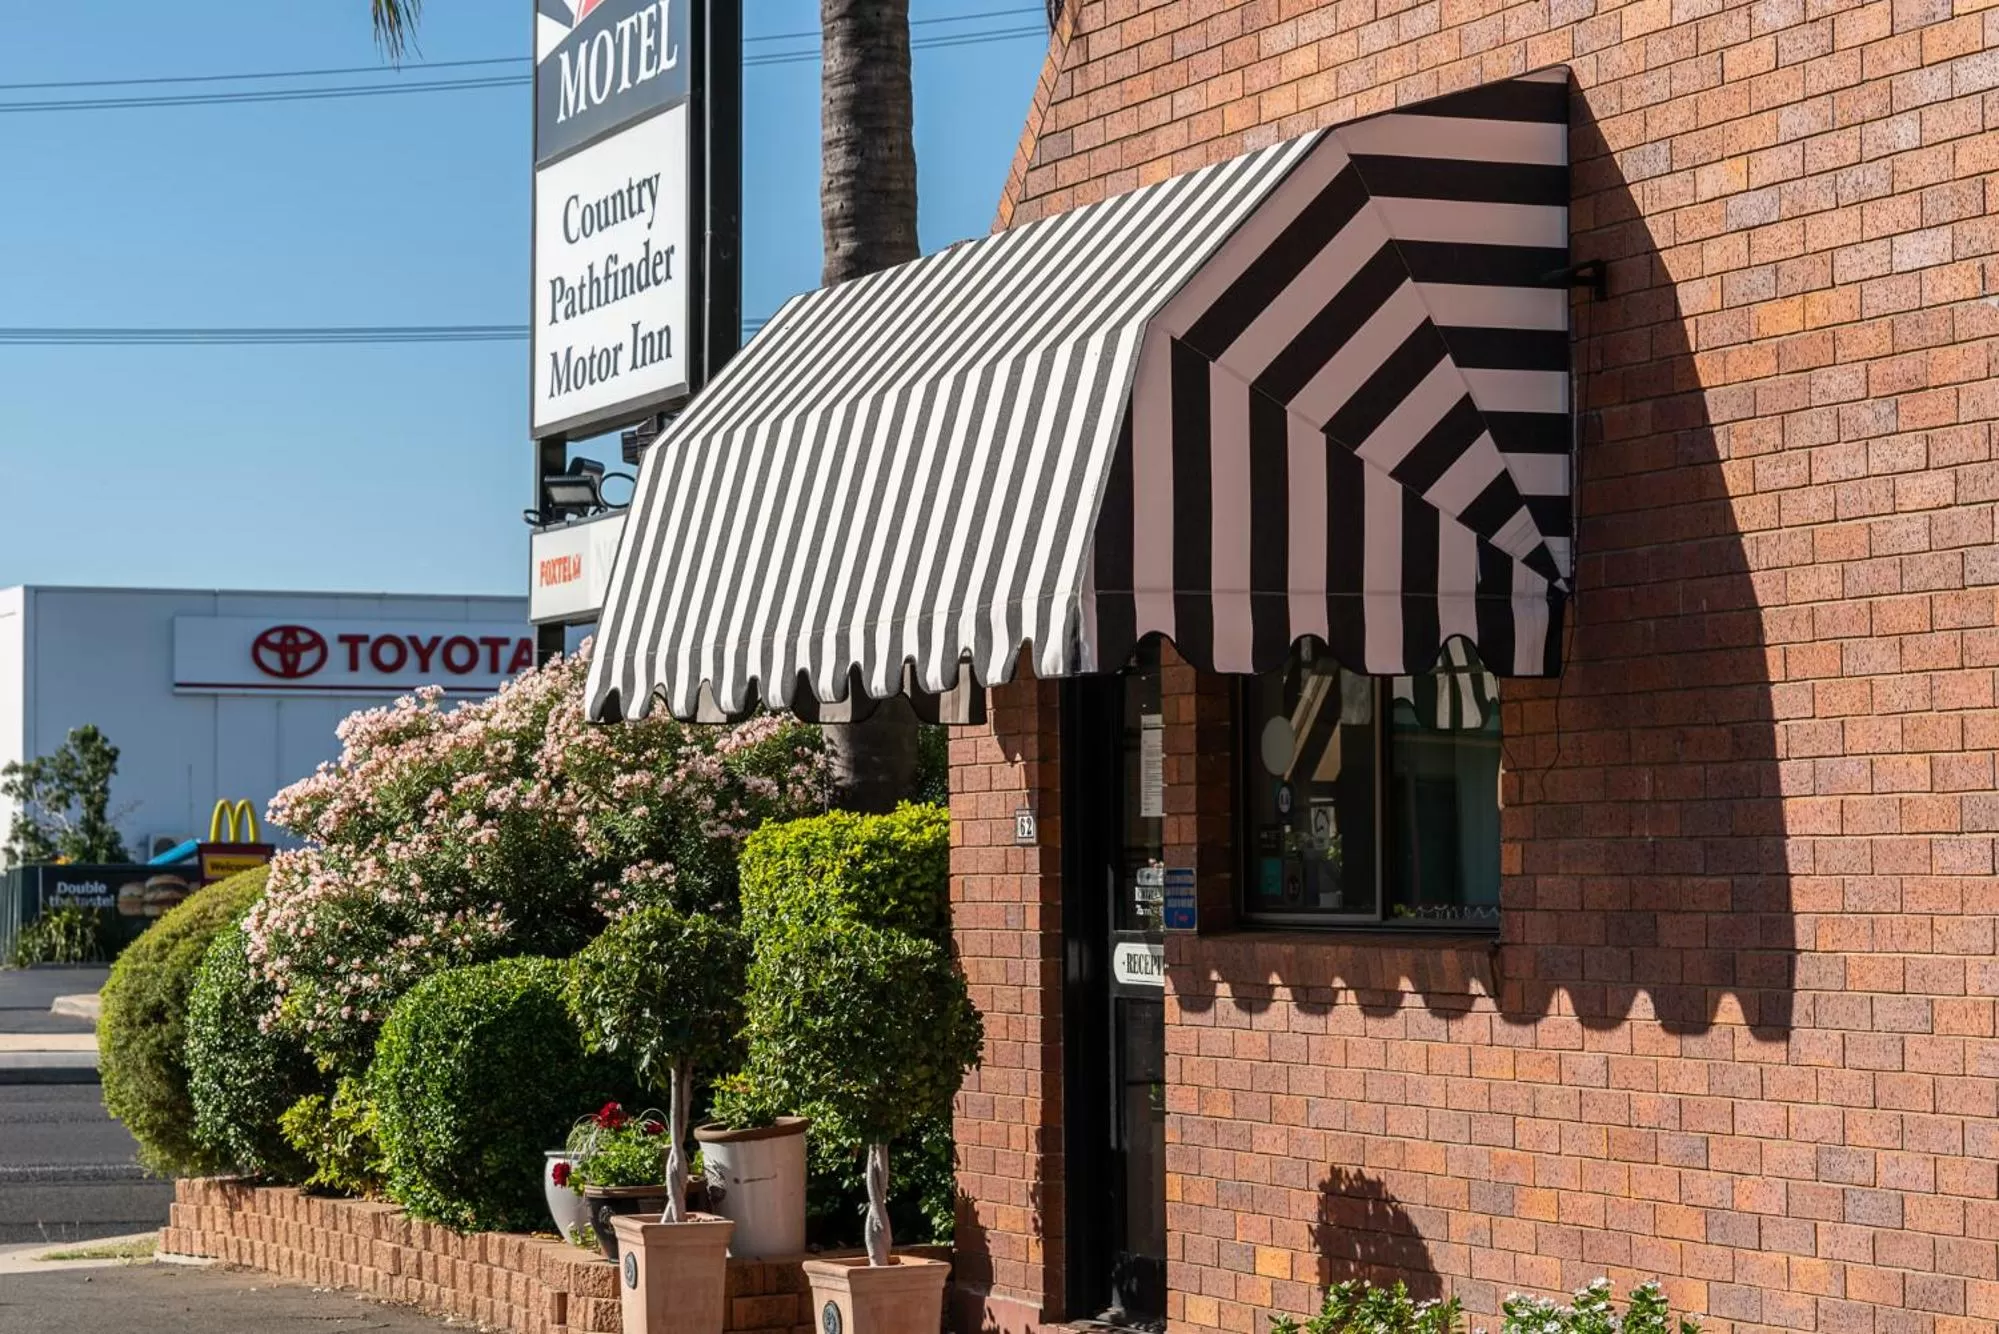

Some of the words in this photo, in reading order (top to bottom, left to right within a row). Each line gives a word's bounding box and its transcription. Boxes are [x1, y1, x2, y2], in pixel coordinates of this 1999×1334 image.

[556, 0, 679, 124] MOTEL
[562, 172, 661, 245] Country
[548, 239, 676, 326] Pathfinder
[548, 338, 623, 400] Motor
[629, 320, 673, 373] Inn
[337, 633, 533, 675] TOYOTA
[1020, 817, 1032, 836] 62
[56, 880, 107, 895] Double
